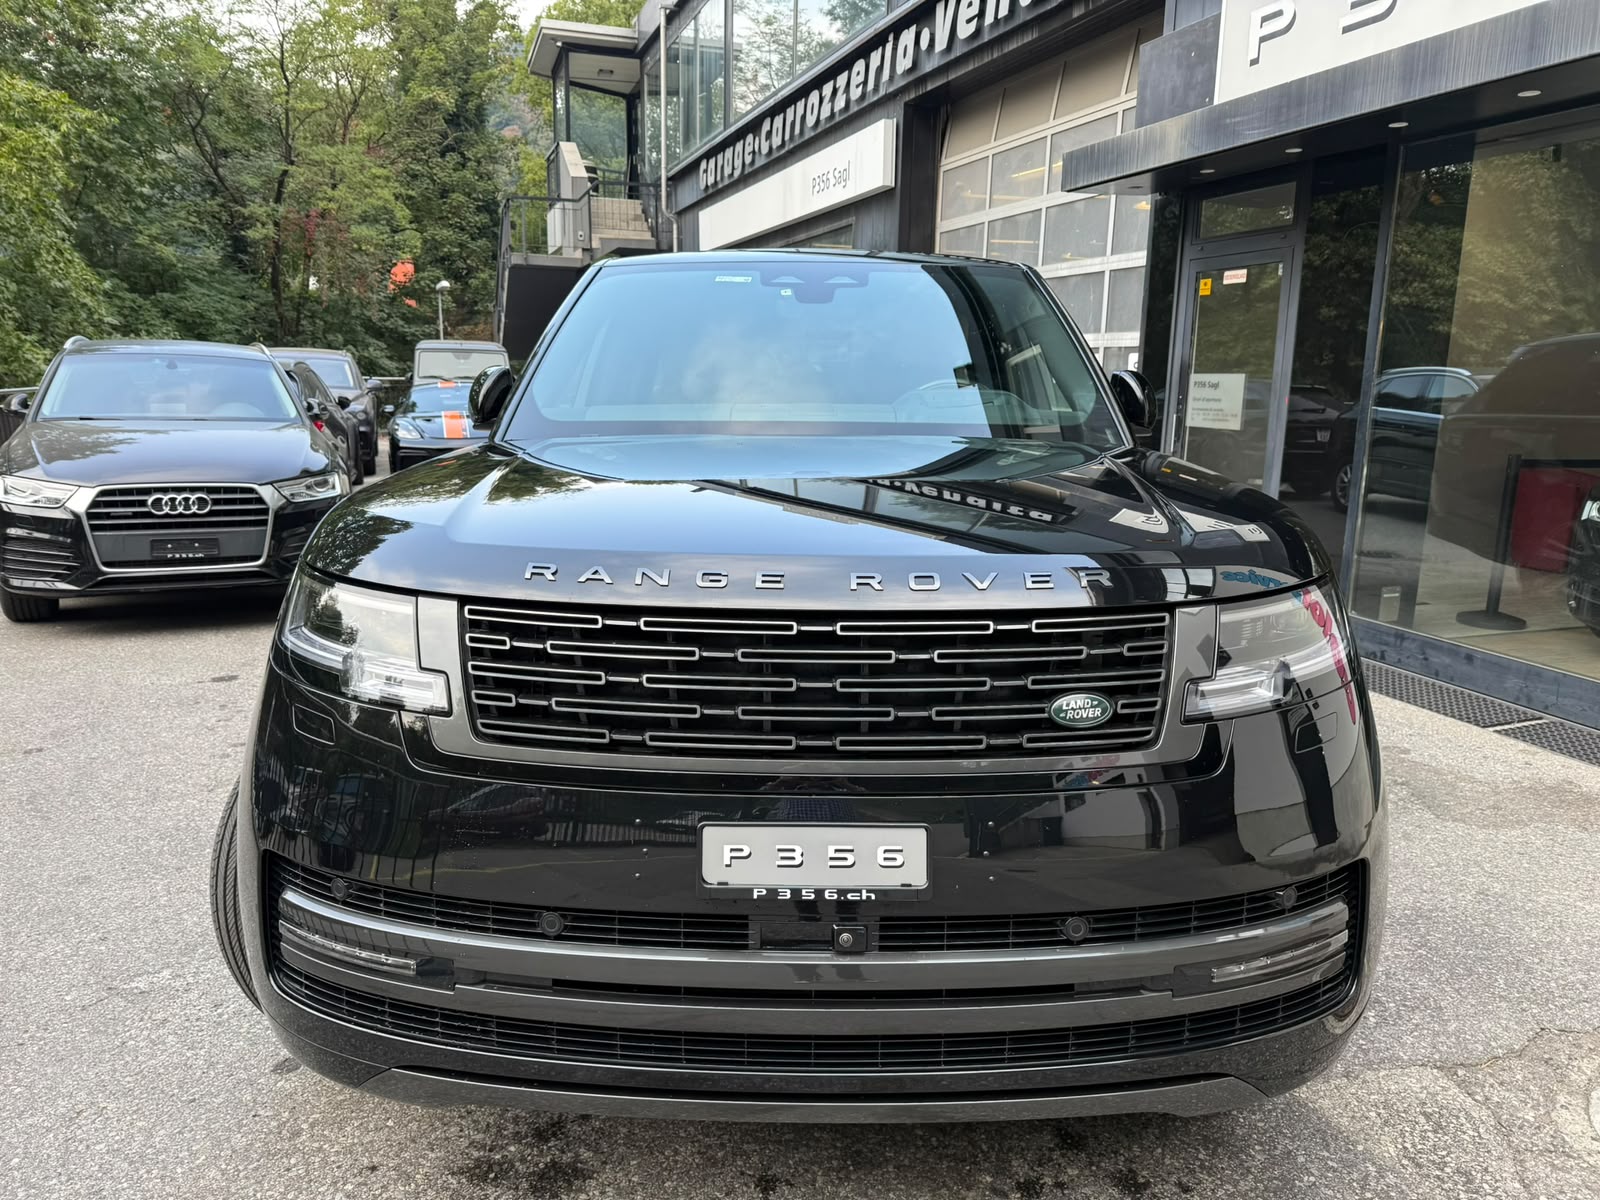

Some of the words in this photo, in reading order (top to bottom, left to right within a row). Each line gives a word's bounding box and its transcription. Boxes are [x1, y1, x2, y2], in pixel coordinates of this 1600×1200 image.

[935, 0, 1034, 53] Ven
[811, 170, 830, 197] P356
[832, 159, 851, 189] Sagl
[524, 561, 785, 590] RANGE
[849, 569, 1113, 592] ROVER
[1062, 698, 1092, 710] LAND
[1066, 708, 1102, 720] ROVER
